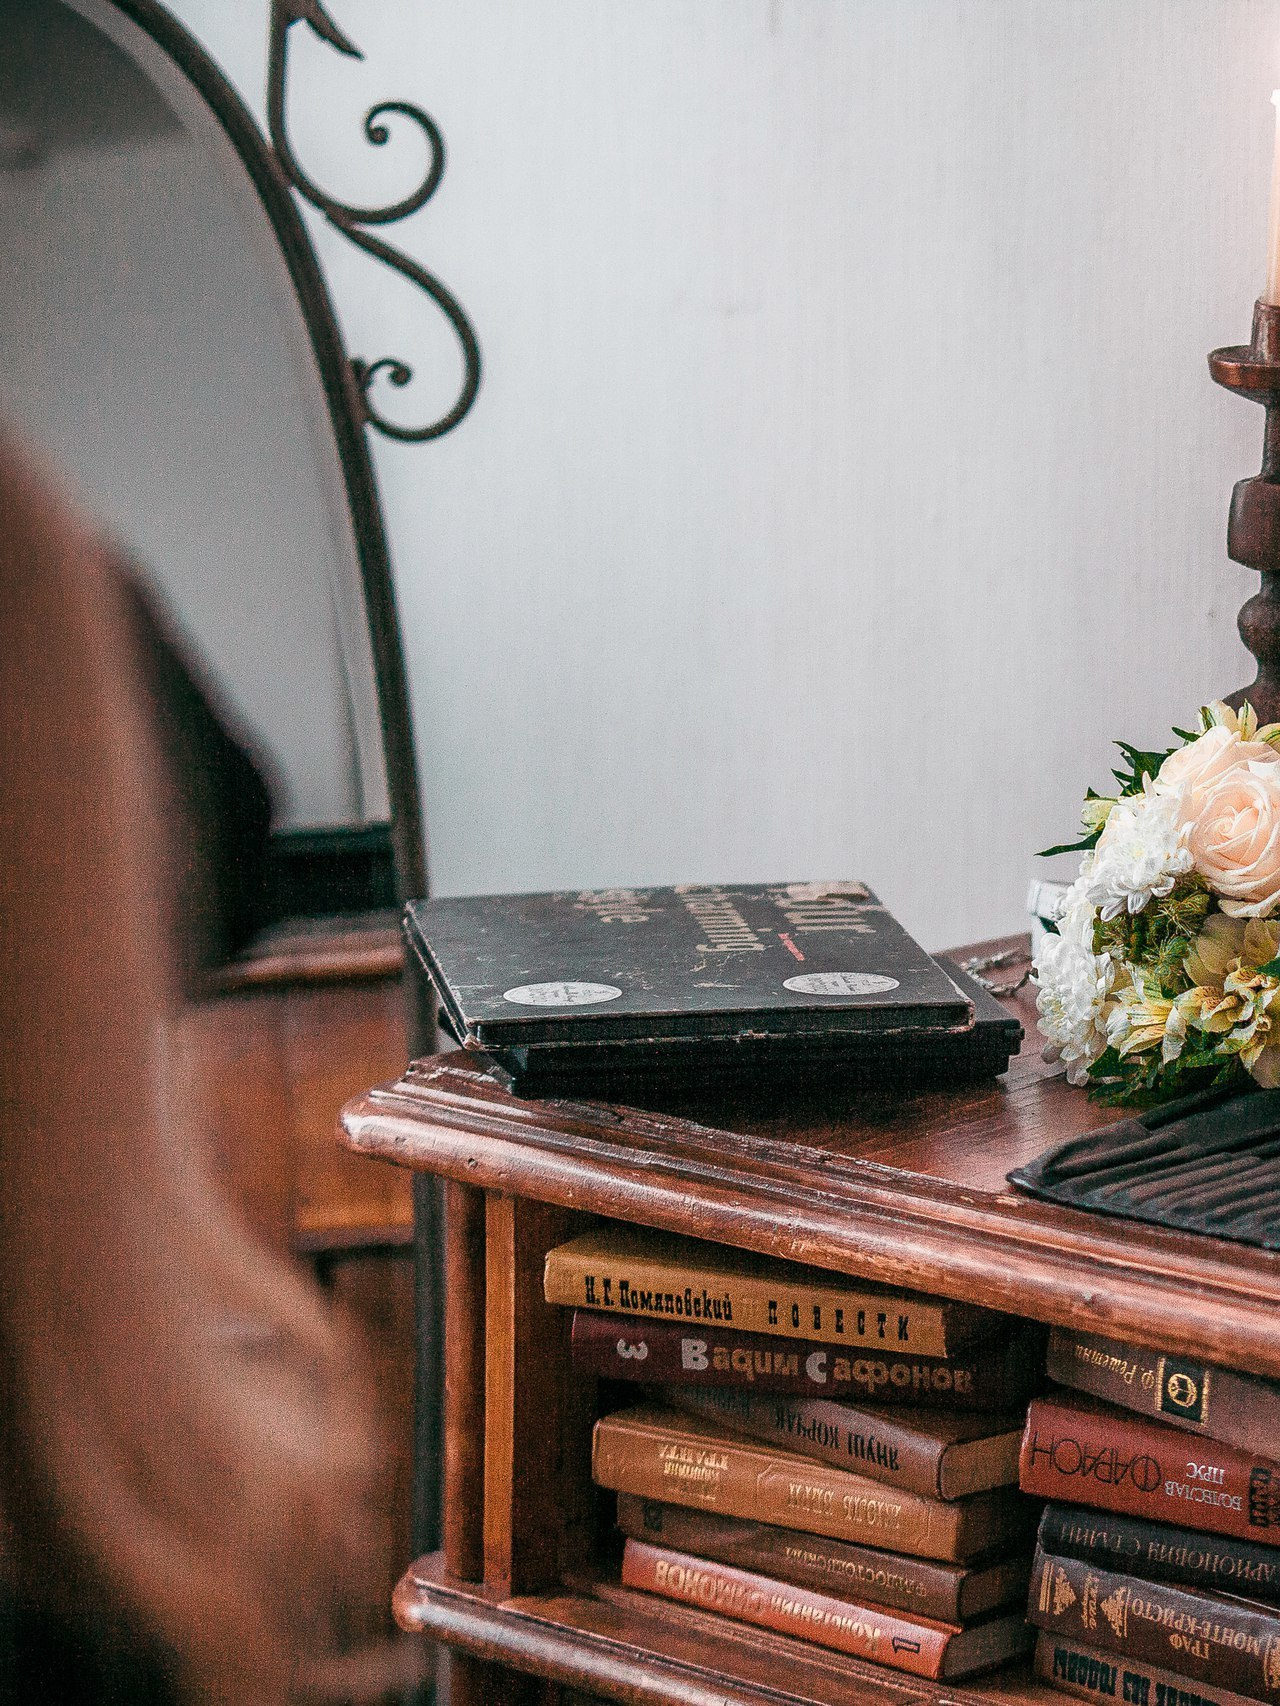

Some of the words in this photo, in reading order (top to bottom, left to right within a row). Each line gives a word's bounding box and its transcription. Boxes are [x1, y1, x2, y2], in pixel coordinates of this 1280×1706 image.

[768, 1300, 910, 1342] ПОВЕСТИ
[681, 1338, 799, 1382] Вадим
[806, 1351, 973, 1394] Сафонов
[848, 1433, 900, 1471] ЯНУШ
[1029, 1431, 1162, 1492] ФАРАОН
[1186, 1462, 1226, 1485] ПРУС
[1164, 1480, 1243, 1511] БОЛЕСЛАВ
[655, 1560, 769, 1615] СИМОНОВ
[771, 1596, 882, 1652] Константин
[1131, 1597, 1262, 1657] МОНТЕ-КРИСТО
[1169, 1633, 1210, 1660] ГРАФ
